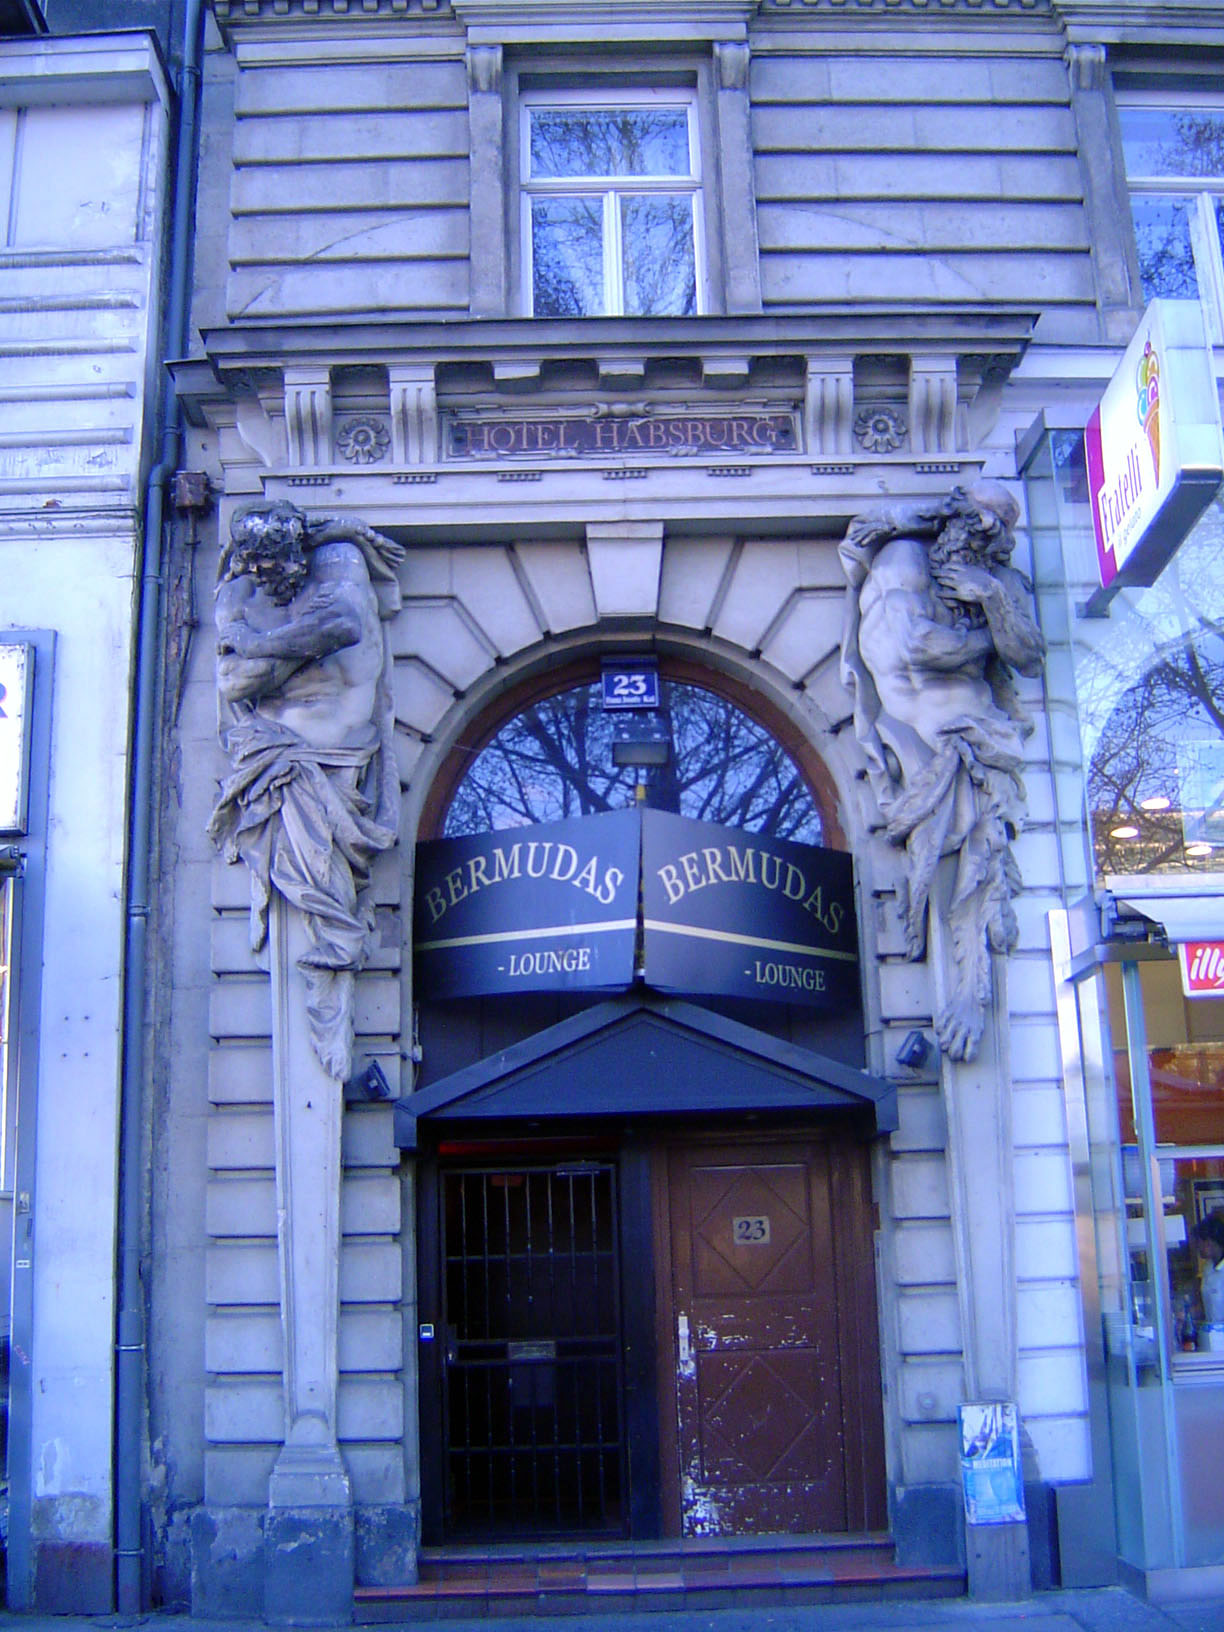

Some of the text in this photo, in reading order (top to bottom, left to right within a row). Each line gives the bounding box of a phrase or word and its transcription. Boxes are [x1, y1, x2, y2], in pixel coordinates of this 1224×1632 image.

[466, 422, 578, 450] HOTEL
[1101, 442, 1142, 544] Fratelli
[613, 675, 647, 695] 23
[425, 842, 624, 924] BERMUDAS
[658, 846, 845, 935] BERMUDAS
[508, 947, 591, 977] LOUNGE
[754, 961, 826, 992] LOUNGE
[738, 1219, 766, 1241] 23
